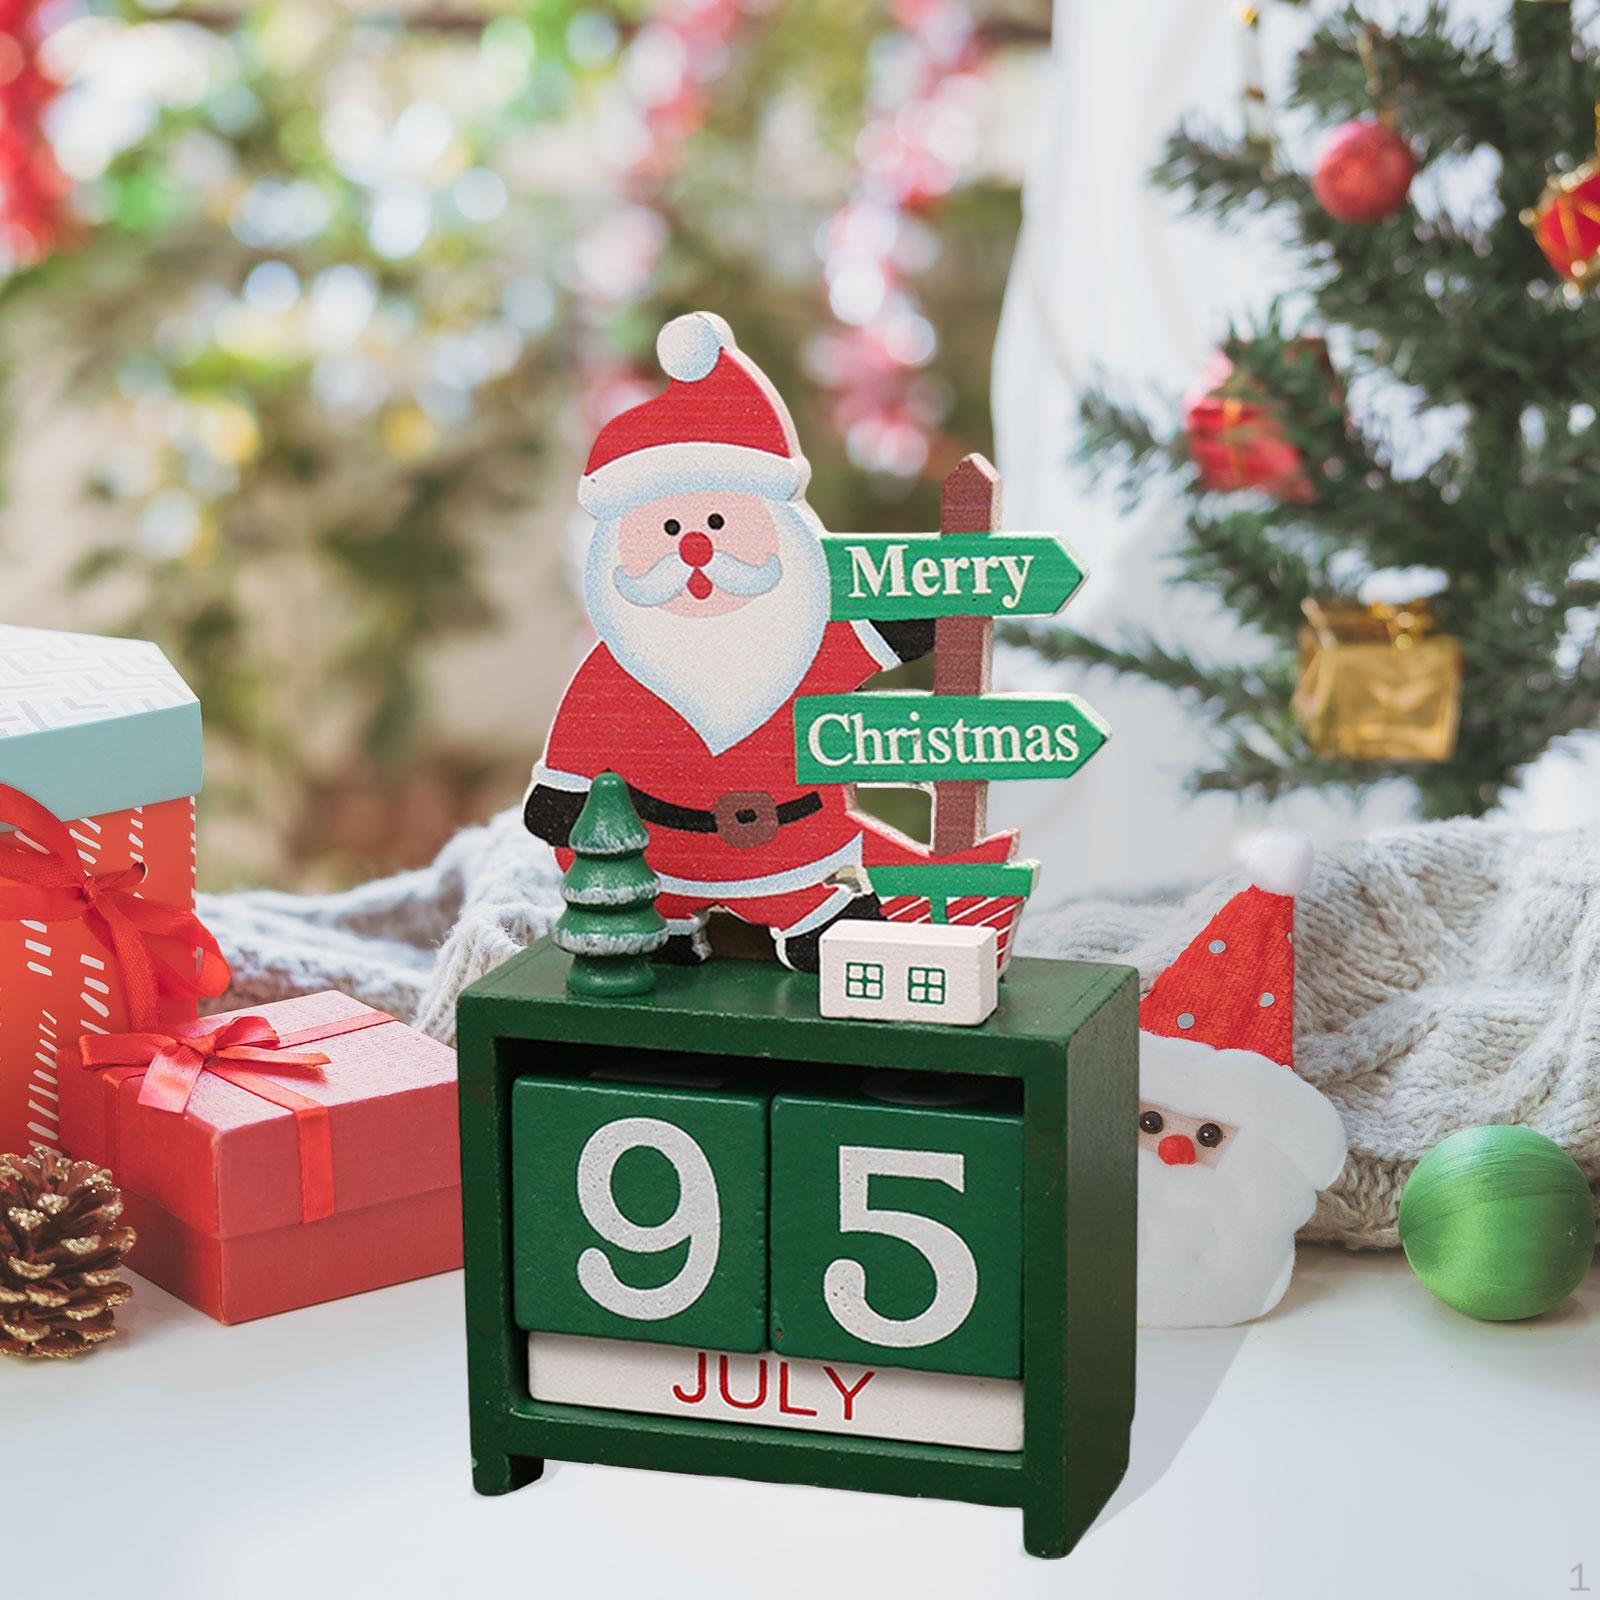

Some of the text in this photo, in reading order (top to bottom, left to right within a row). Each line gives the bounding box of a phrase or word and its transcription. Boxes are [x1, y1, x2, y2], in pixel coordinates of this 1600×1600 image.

[845, 544, 1034, 608] Merry
[807, 711, 1079, 766] Christmas
[673, 1351, 875, 1420] JULY
